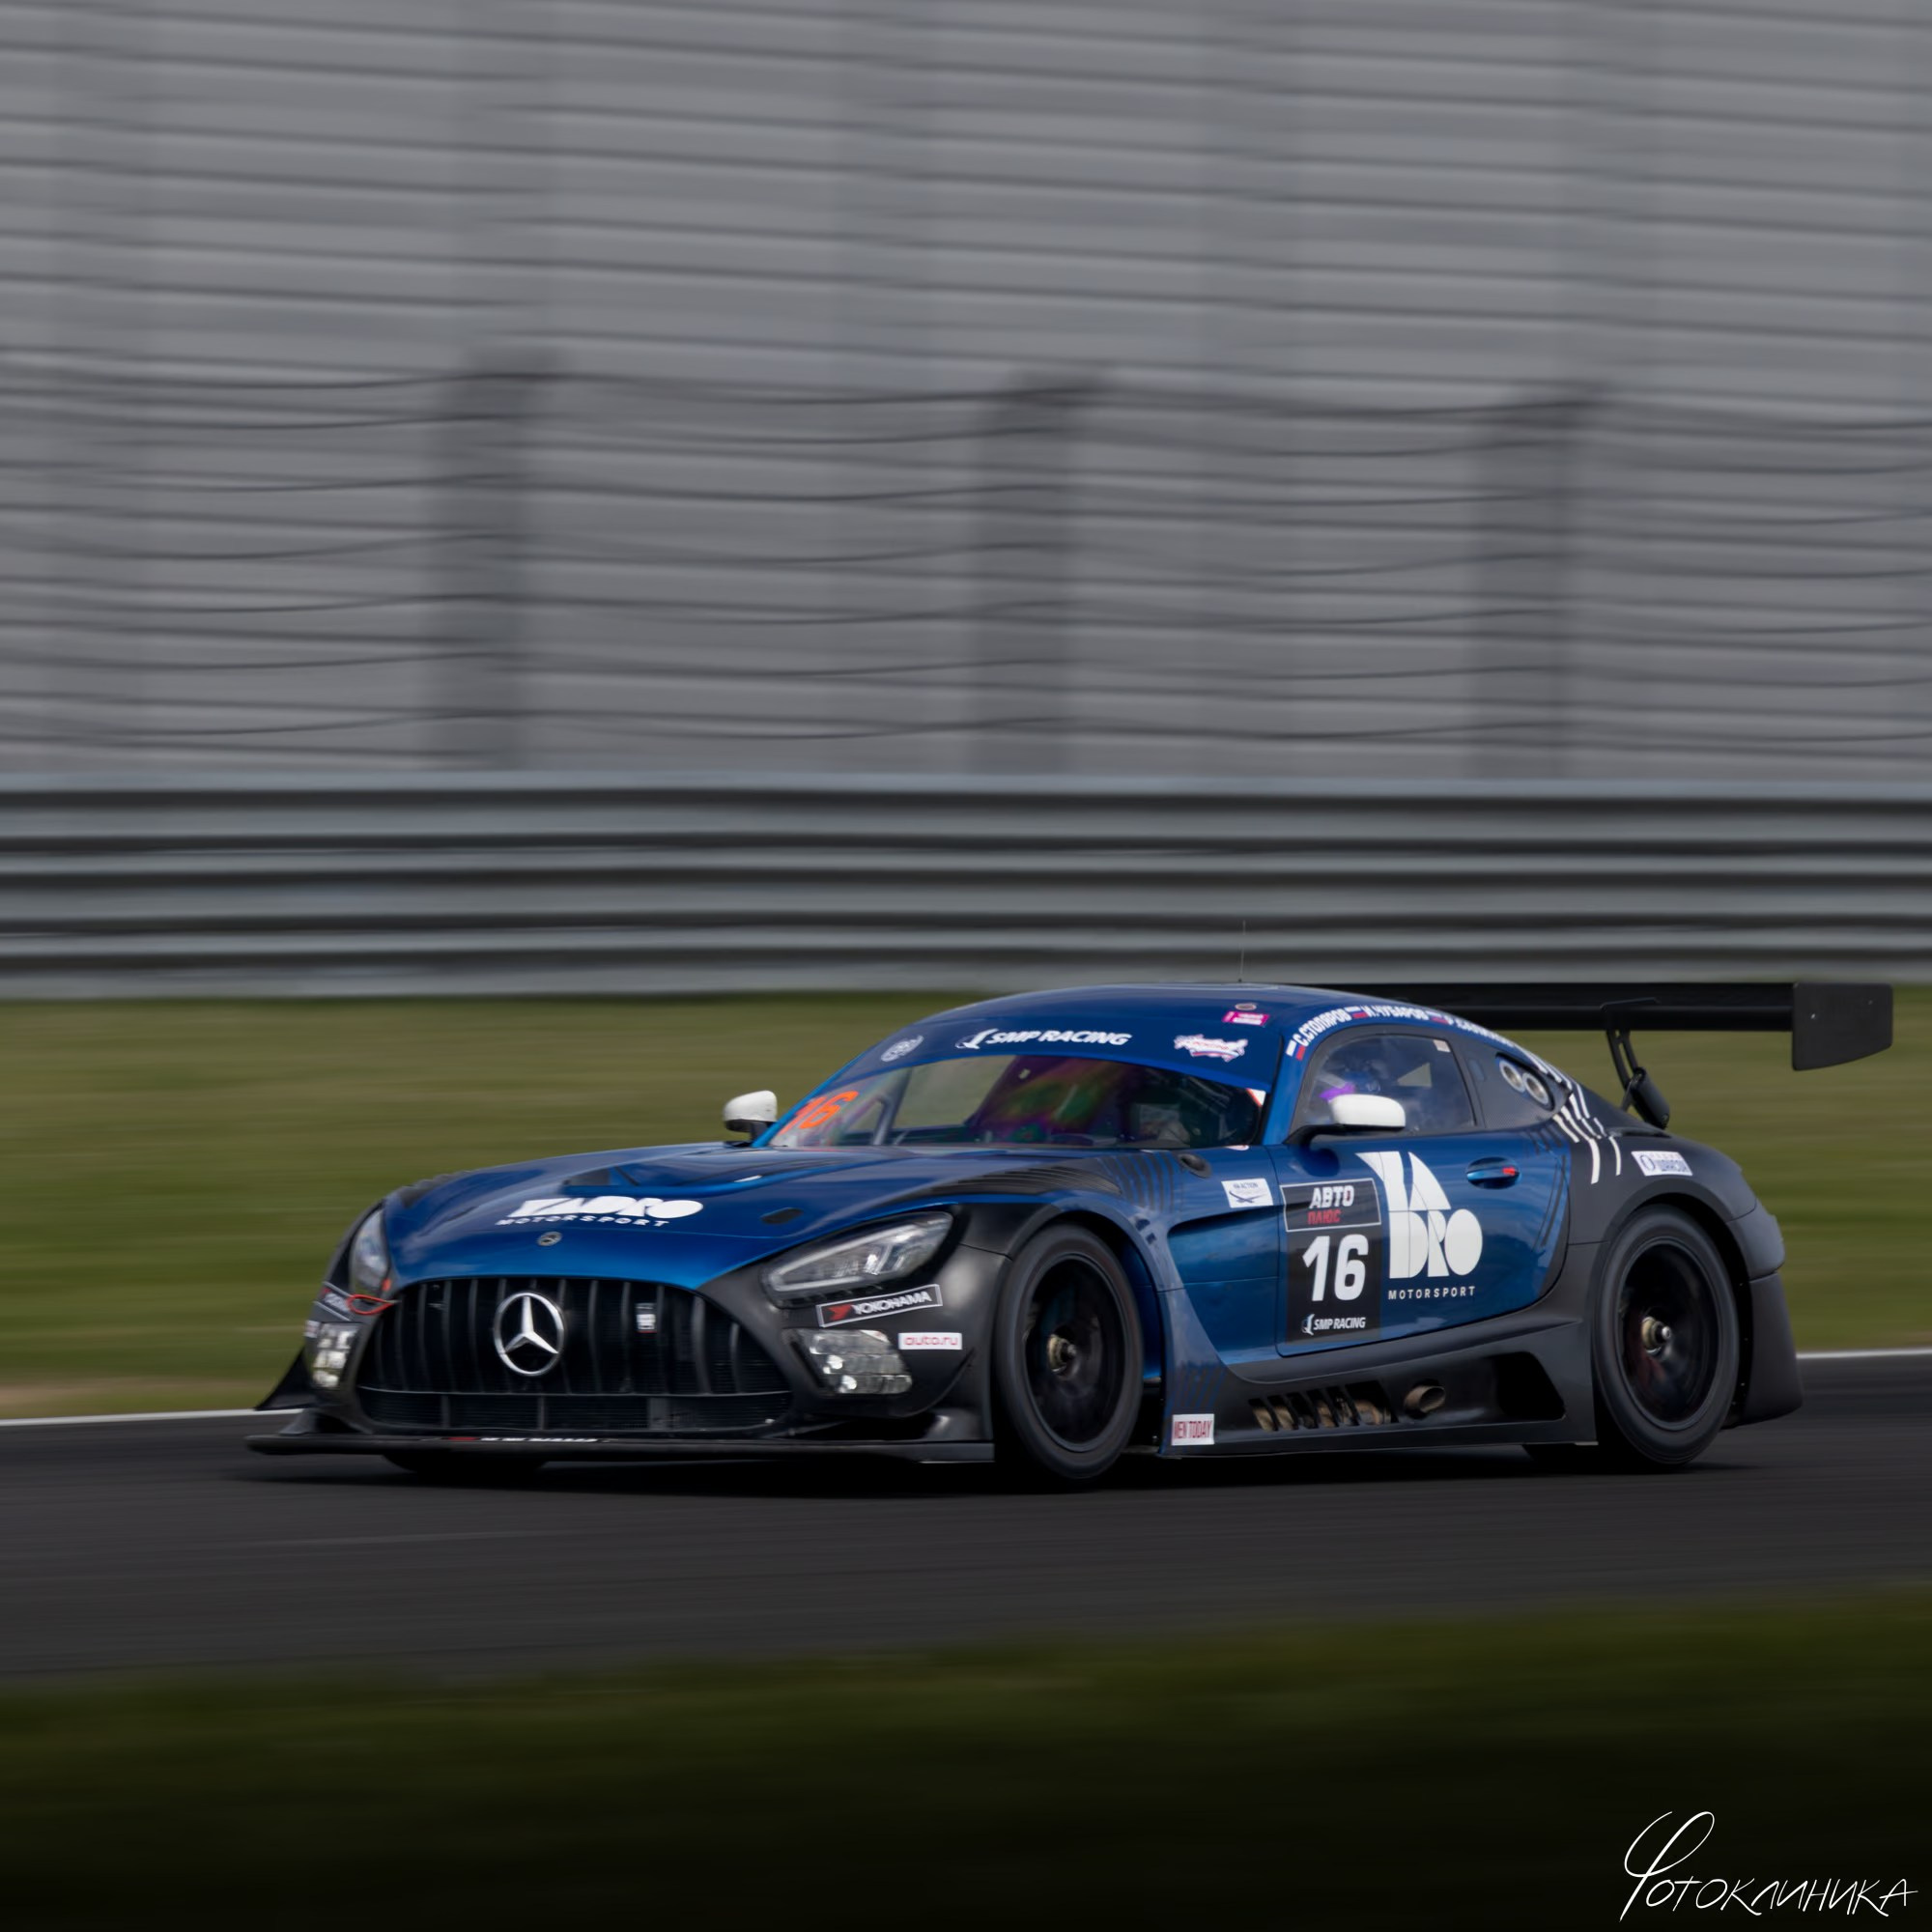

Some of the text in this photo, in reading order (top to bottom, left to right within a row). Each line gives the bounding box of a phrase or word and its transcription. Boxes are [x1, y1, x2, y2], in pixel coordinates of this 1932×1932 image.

[985, 1030, 1132, 1046] SMP RACING
[777, 1091, 859, 1135] 16
[1309, 1184, 1355, 1209] АВТО
[495, 1214, 669, 1227] MOTORSPORT
[1307, 1209, 1342, 1225] ПЛЮС
[1302, 1234, 1369, 1301] 16
[1387, 1286, 1475, 1300] MOTORSPORT
[850, 1291, 932, 1315] YOKOHAMA
[1313, 1317, 1366, 1331] SMP RACING
[904, 1335, 958, 1347] auto.ru
[1189, 1420, 1212, 1438] TODAY
